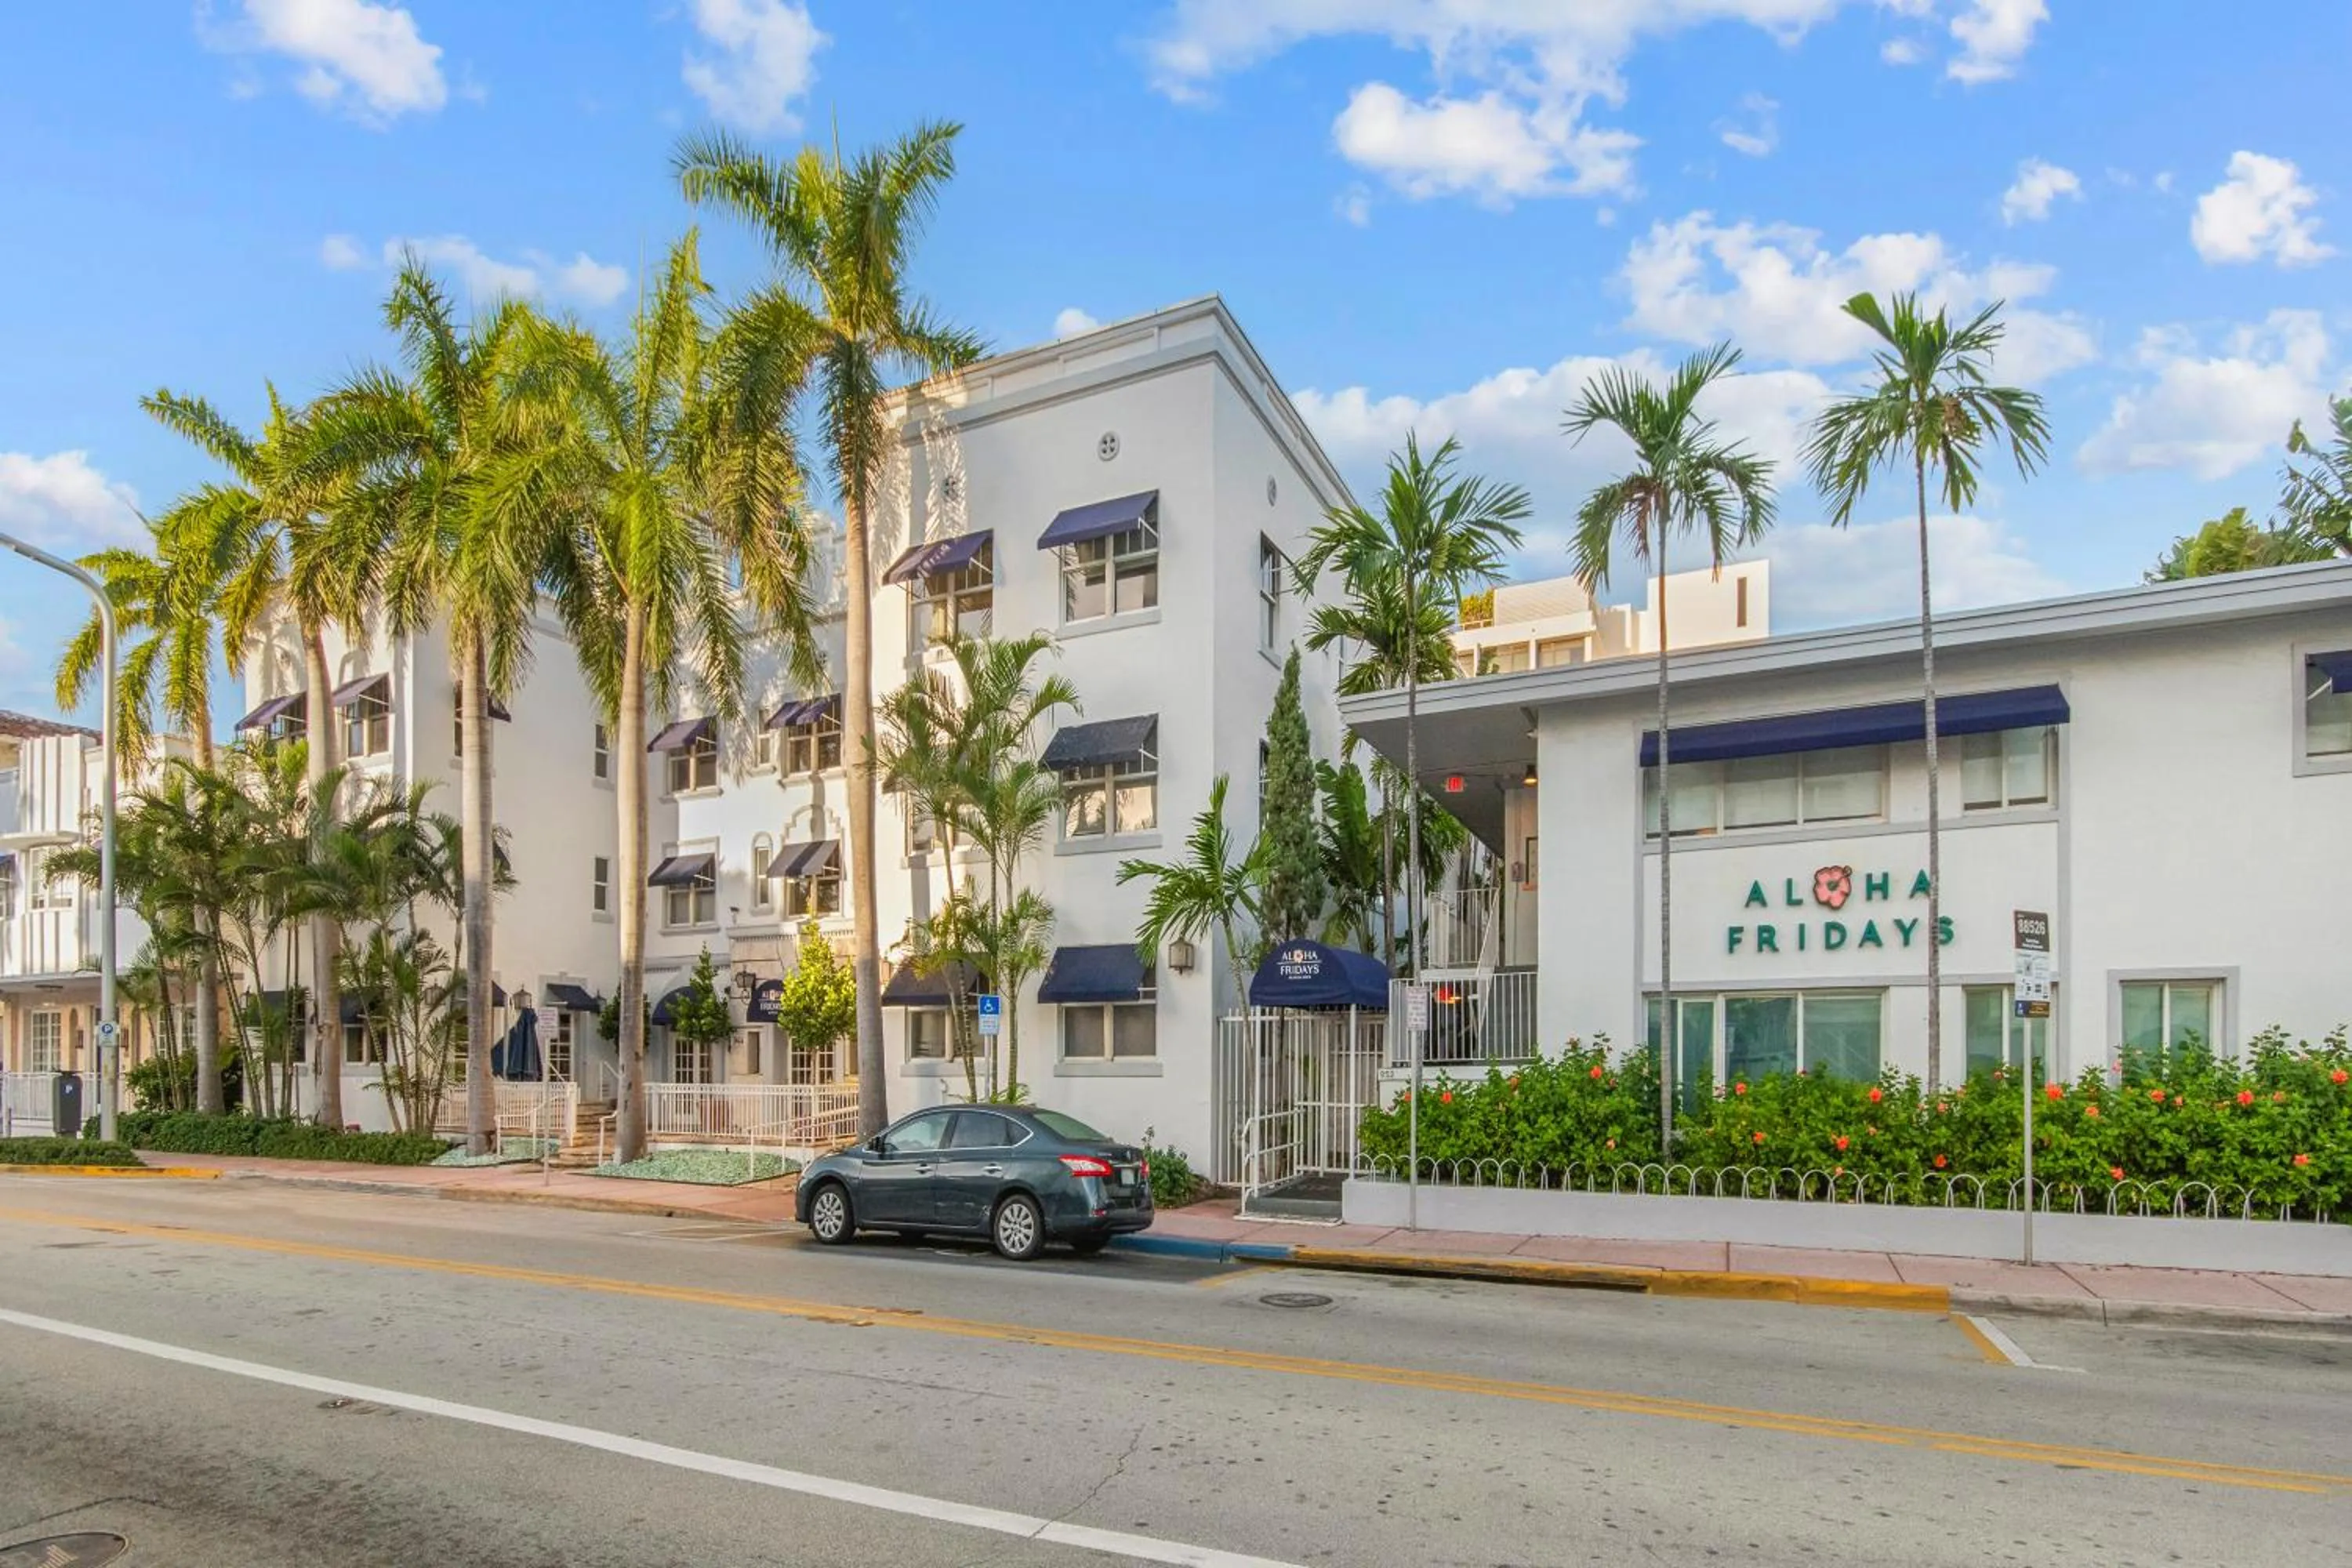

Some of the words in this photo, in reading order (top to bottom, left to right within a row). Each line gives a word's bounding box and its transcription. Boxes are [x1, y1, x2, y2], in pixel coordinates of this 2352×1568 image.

[1745, 866, 1931, 909] ALOHA
[1728, 916, 1955, 954] FRIDAYS
[1282, 949, 1318, 963] ALOHA
[1280, 964, 1319, 975] FRIDAYS
